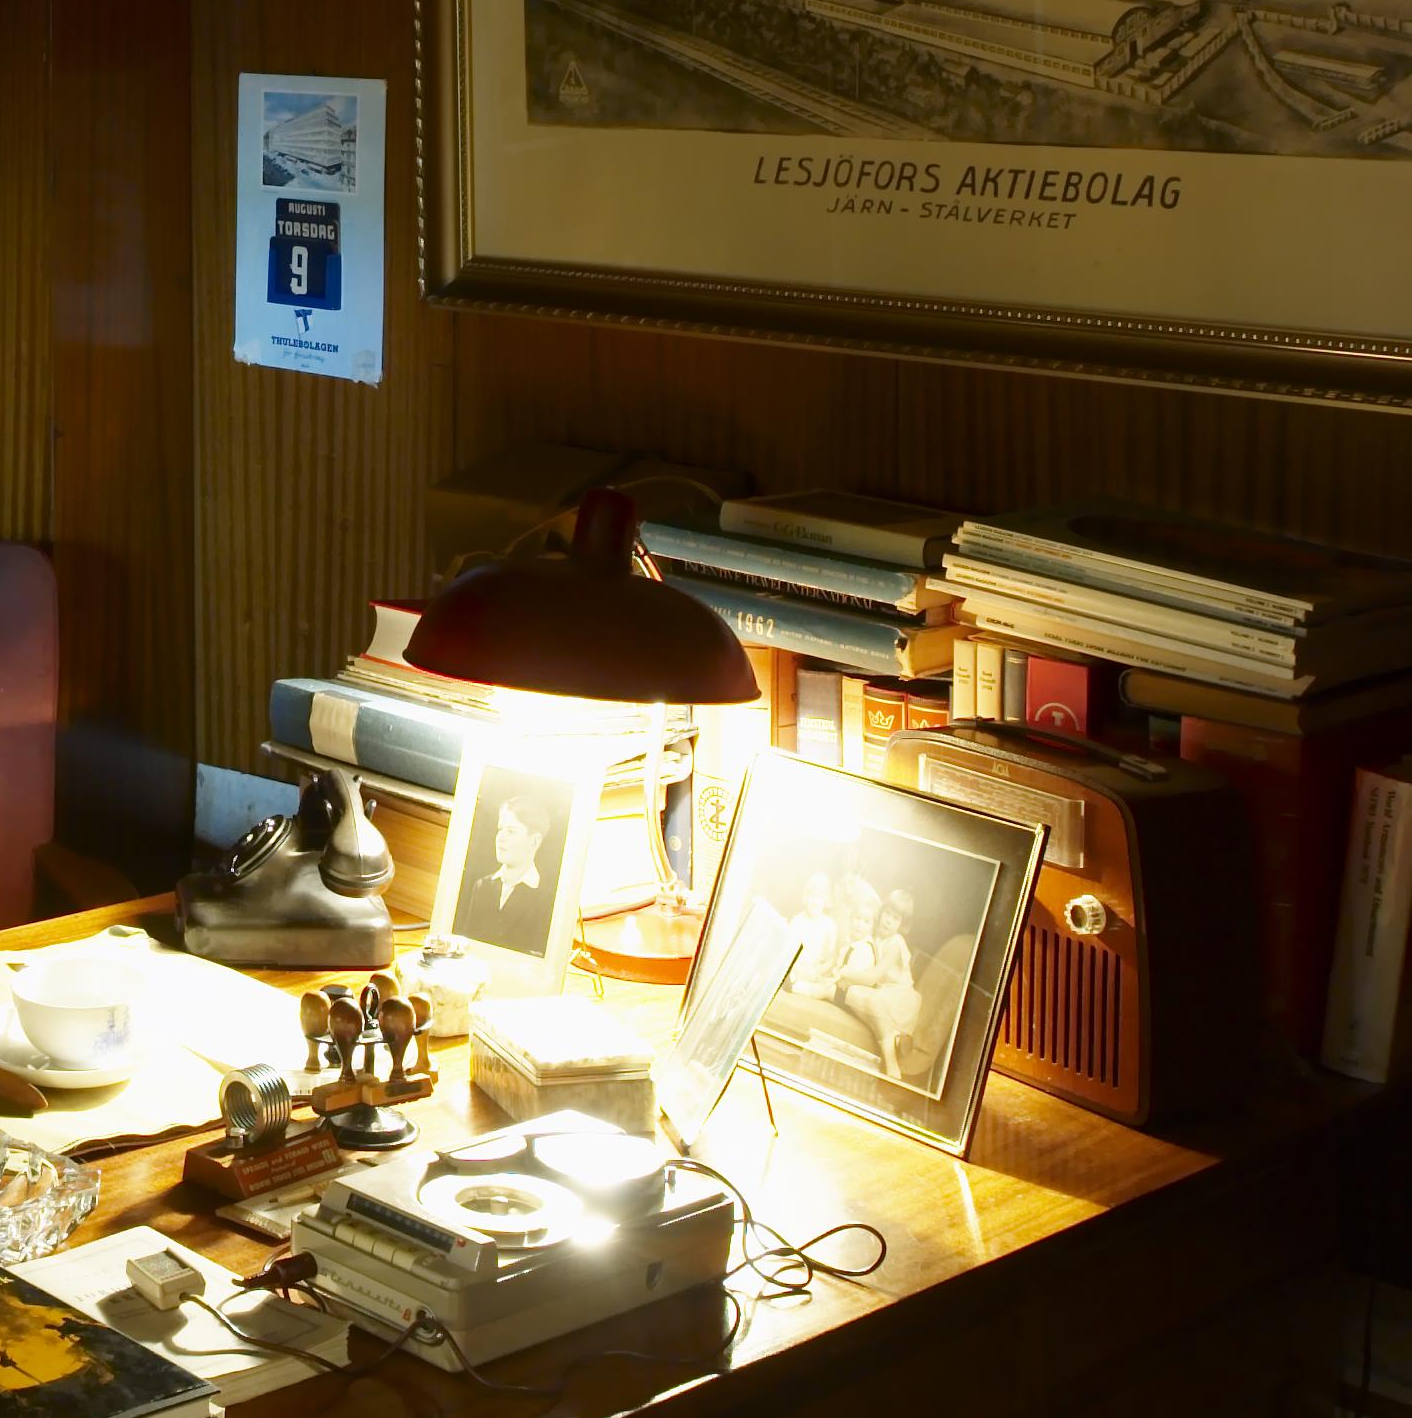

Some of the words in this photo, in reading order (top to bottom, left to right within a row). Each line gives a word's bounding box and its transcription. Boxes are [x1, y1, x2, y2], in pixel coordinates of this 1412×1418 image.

[753, 153, 942, 193] LESJÖFORS
[956, 165, 1183, 210] AKTIEBOLAG
[288, 202, 326, 216] AUGUSTI
[825, 194, 894, 215] JÄRN
[919, 199, 1078, 230] STÅLVERKET
[277, 220, 335, 241] TORSDAG
[289, 245, 309, 295] 9
[271, 335, 339, 353] THULEBOLAGEN
[737, 611, 775, 638] 1962
